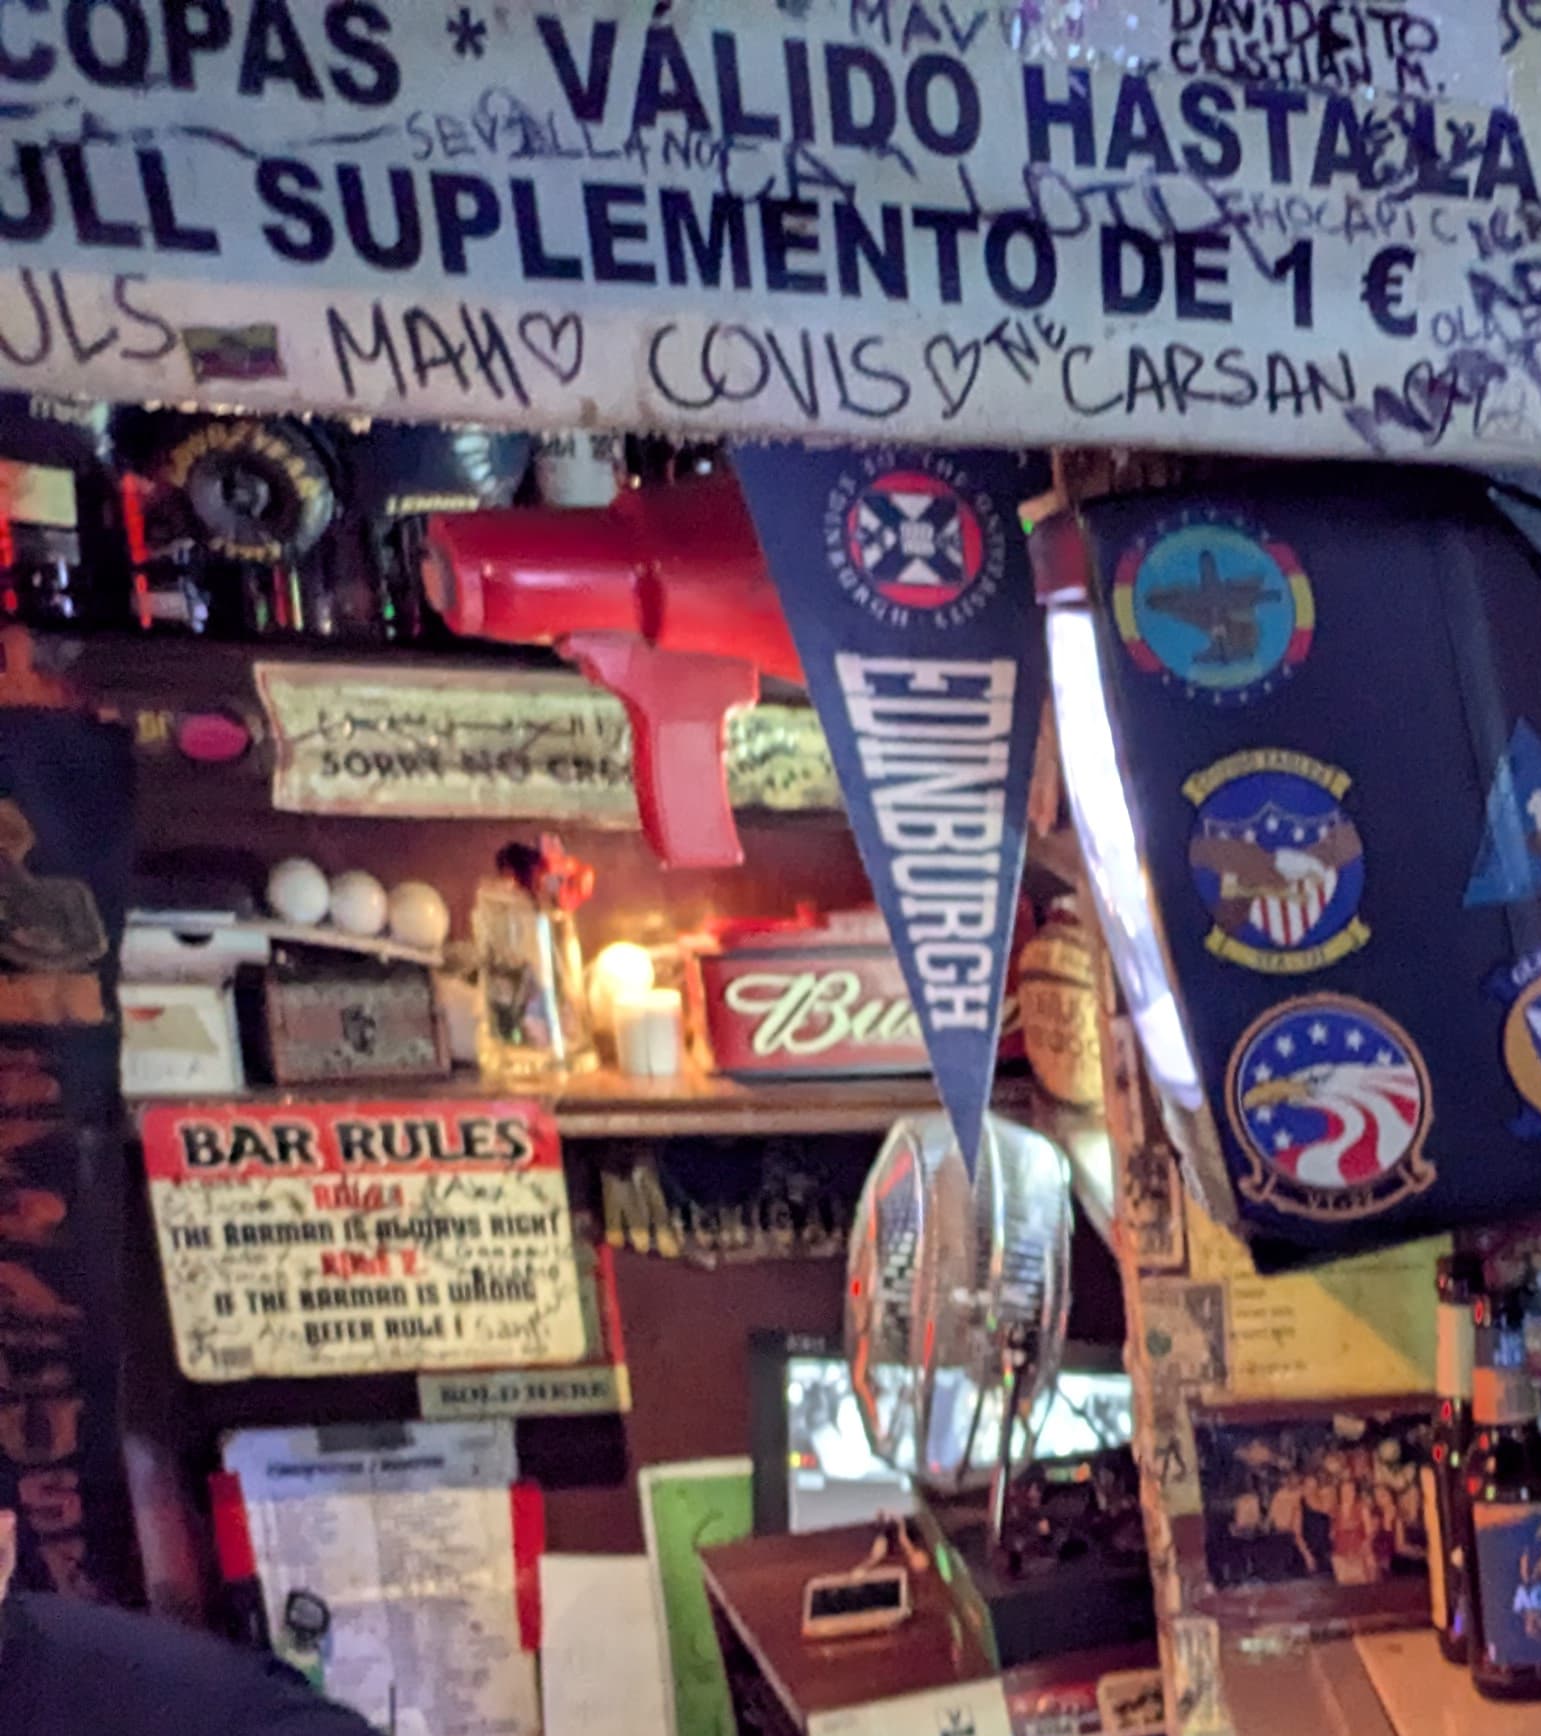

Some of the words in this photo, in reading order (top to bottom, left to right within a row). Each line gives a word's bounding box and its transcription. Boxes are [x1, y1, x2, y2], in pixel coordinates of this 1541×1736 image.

[0, 0, 402, 108] COPAS
[1022, 64, 1380, 190] HASTA
[1413, 98, 1541, 200] LA
[255, 157, 1057, 308] SUPLEMENTO
[1100, 228, 1234, 322] DE
[1273, 239, 1314, 328] 1
[1360, 246, 1418, 338] €
[833, 652, 1019, 1032] EDINBURGH
[178, 1121, 319, 1168] BAR
[334, 1116, 534, 1166] RULES
